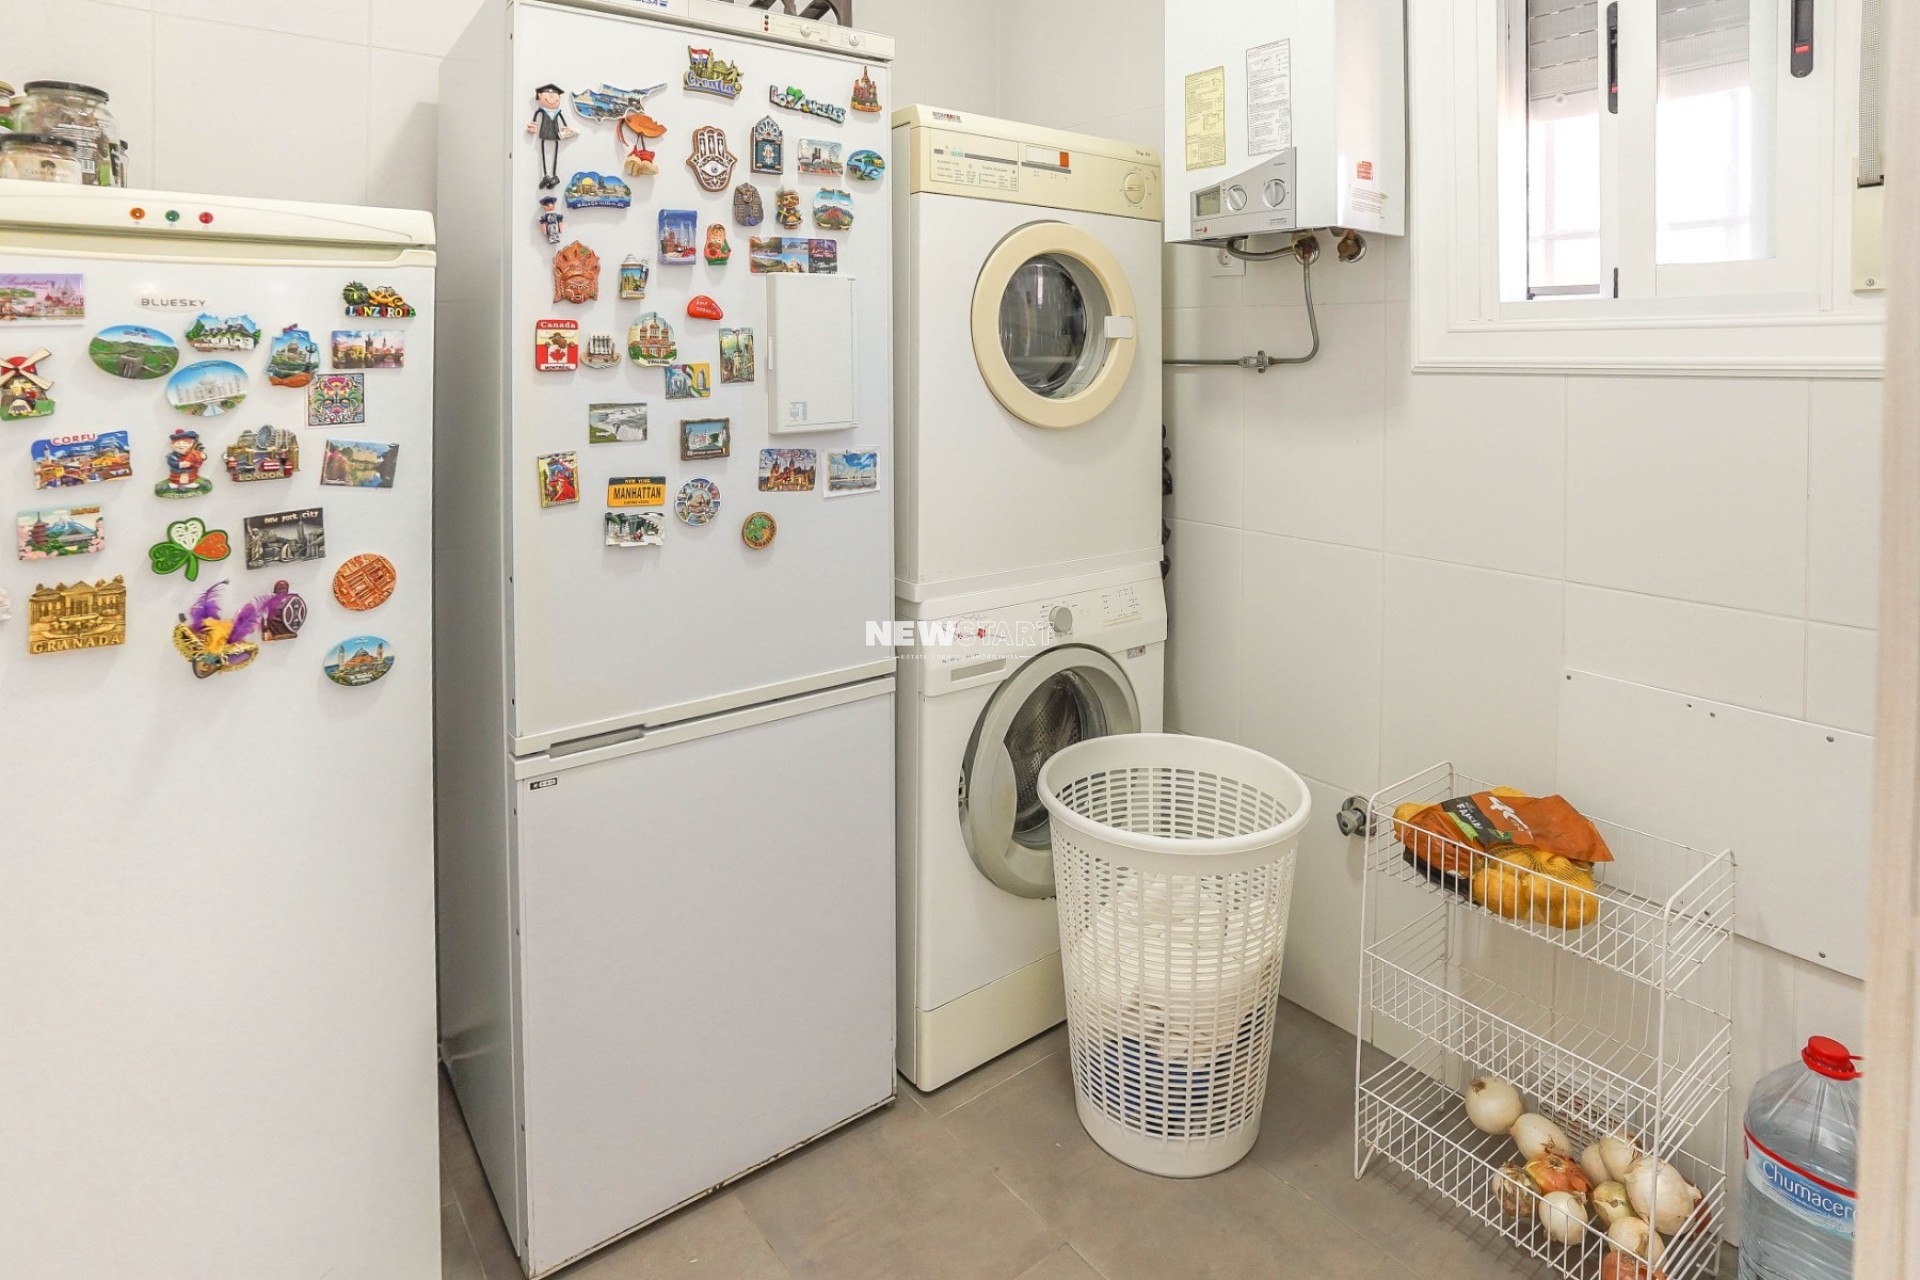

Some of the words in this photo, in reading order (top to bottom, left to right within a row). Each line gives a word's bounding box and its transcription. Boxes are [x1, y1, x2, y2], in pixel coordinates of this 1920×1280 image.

[687, 71, 737, 94] Croatia
[141, 298, 206, 307] BLUESKY
[348, 305, 416, 318] LANZAROTE
[541, 321, 576, 329] Canada
[52, 433, 96, 445] CORFU
[239, 471, 285, 481] LONDON
[613, 486, 662, 500] MANHATTAN
[281, 512, 299, 523] york
[302, 510, 319, 518] city
[32, 636, 120, 653] GRANADA
